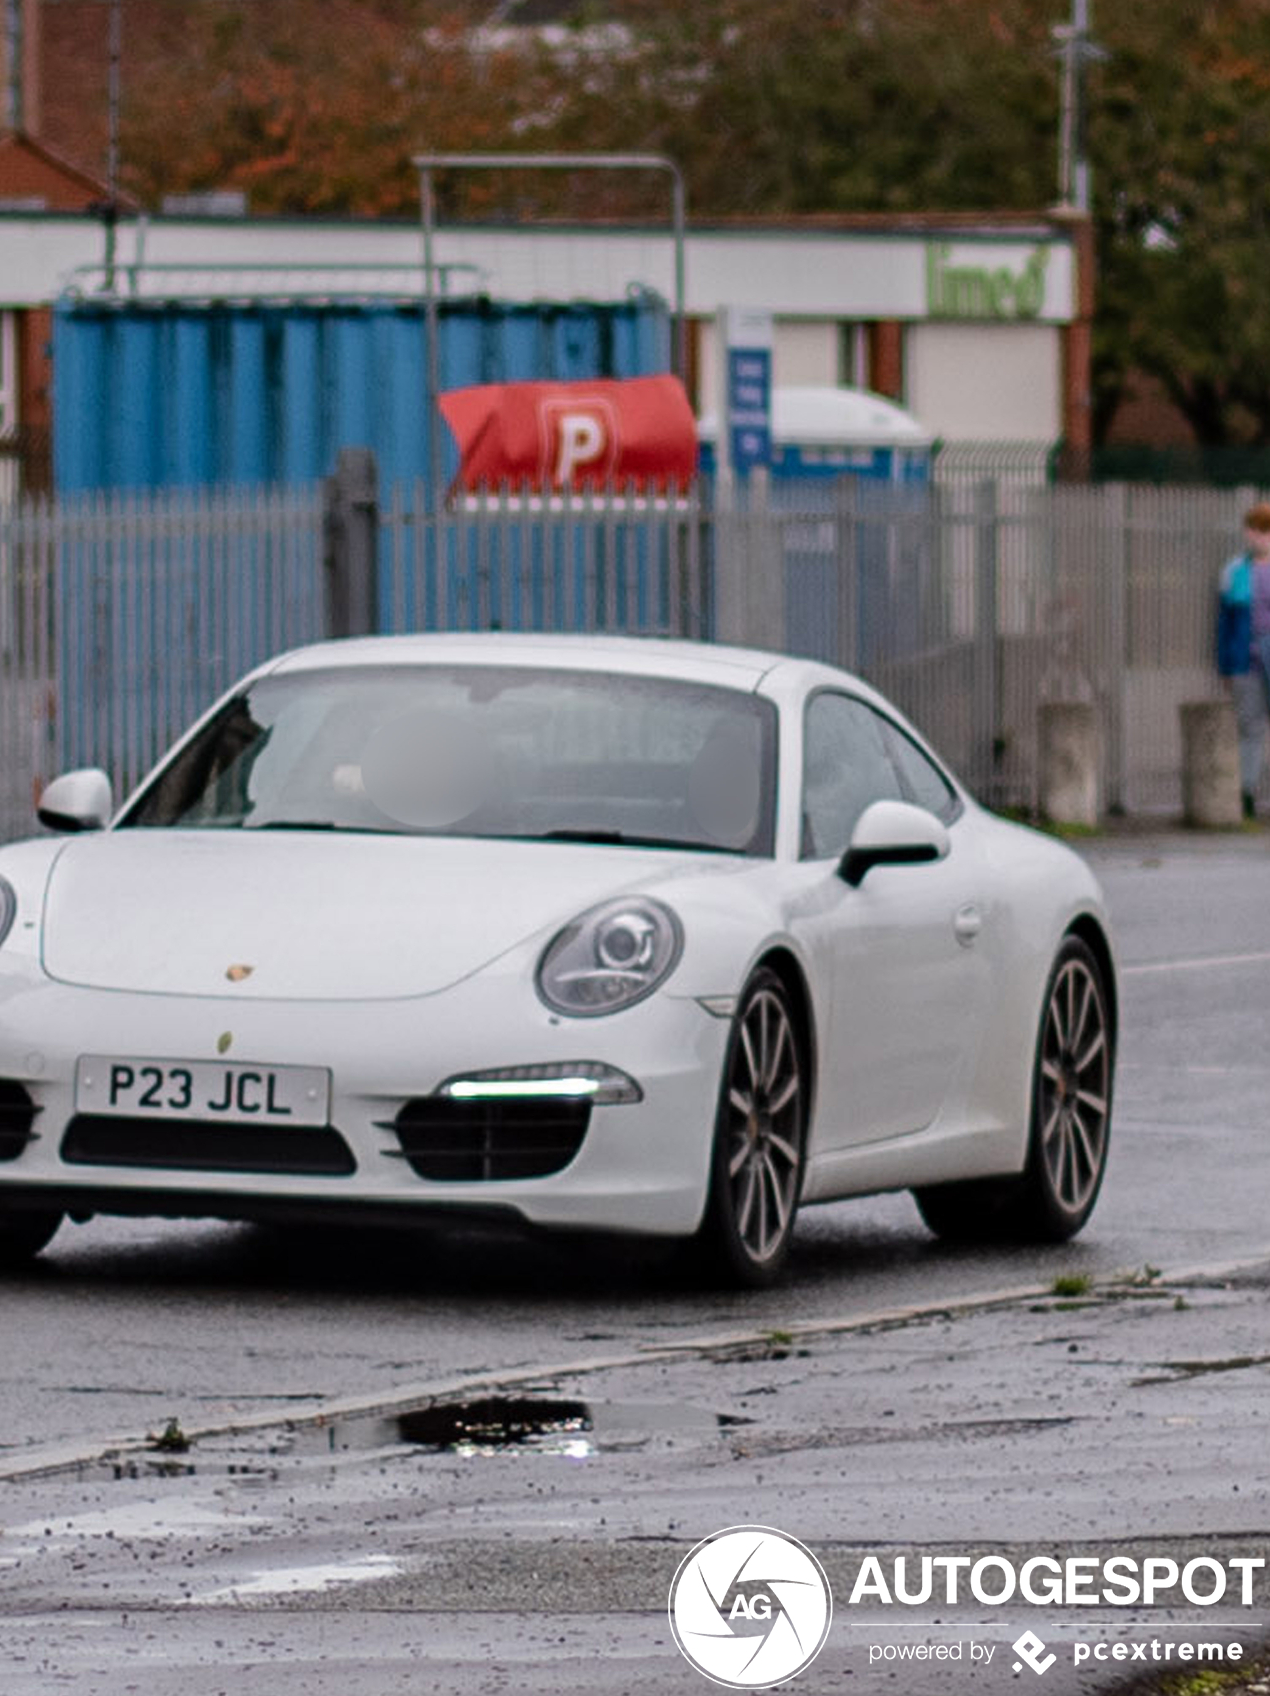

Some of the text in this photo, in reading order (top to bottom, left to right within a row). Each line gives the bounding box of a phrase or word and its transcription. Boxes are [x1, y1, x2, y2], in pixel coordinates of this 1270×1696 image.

[556, 414, 606, 487] P
[109, 1063, 293, 1115] P23 JCL
